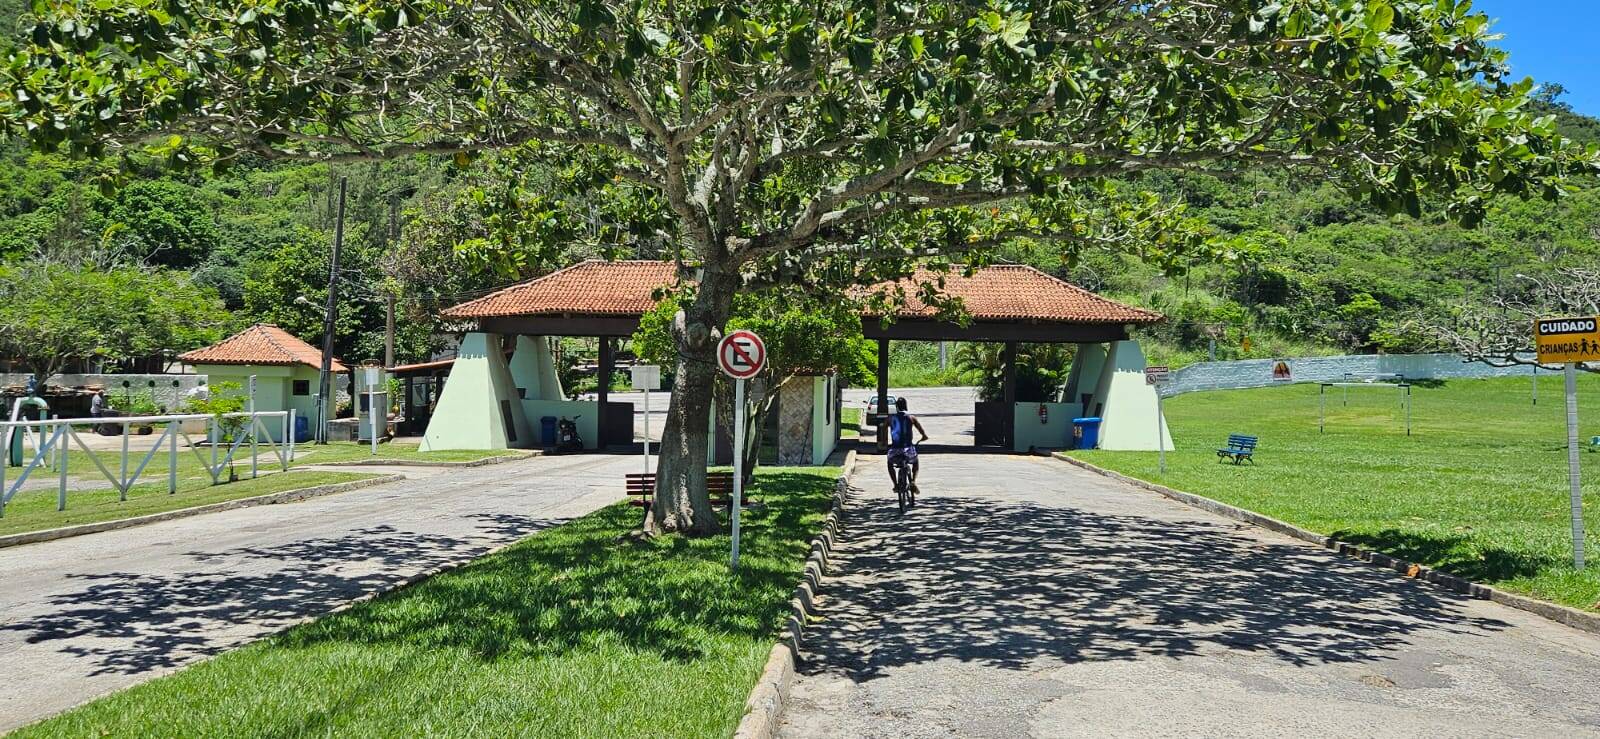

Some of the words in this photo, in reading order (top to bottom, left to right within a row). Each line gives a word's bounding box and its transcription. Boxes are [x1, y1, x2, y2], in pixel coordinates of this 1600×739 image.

[1540, 321, 1594, 332] CUIDADO
[733, 342, 751, 365] E
[1540, 343, 1578, 355] CRIANÇAS
